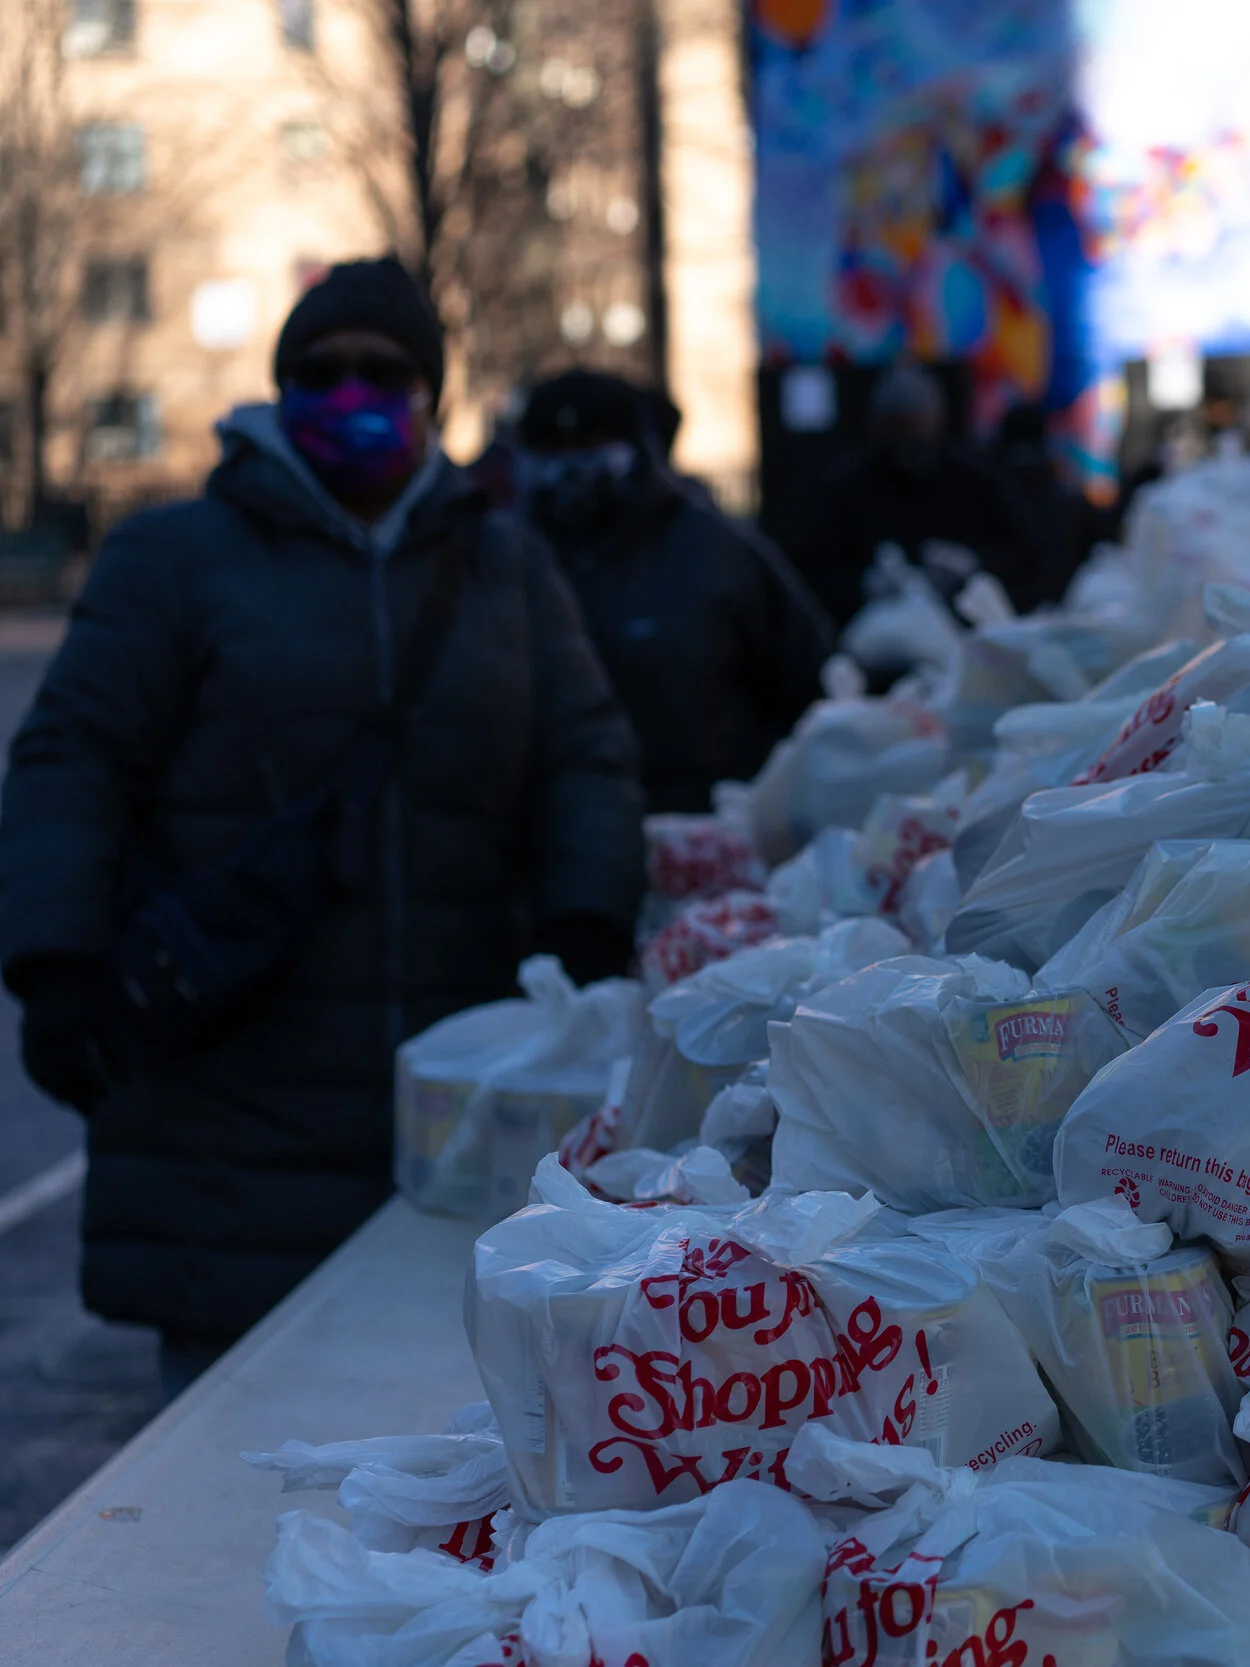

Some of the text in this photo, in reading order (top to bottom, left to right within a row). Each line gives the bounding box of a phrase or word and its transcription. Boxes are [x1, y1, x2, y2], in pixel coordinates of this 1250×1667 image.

[1105, 1134, 1155, 1160] Please
[1160, 1147, 1201, 1172] return
[1205, 1158, 1234, 1184] this
[1212, 1209, 1228, 1222] USE
[964, 1422, 1037, 1471] ecycling.
